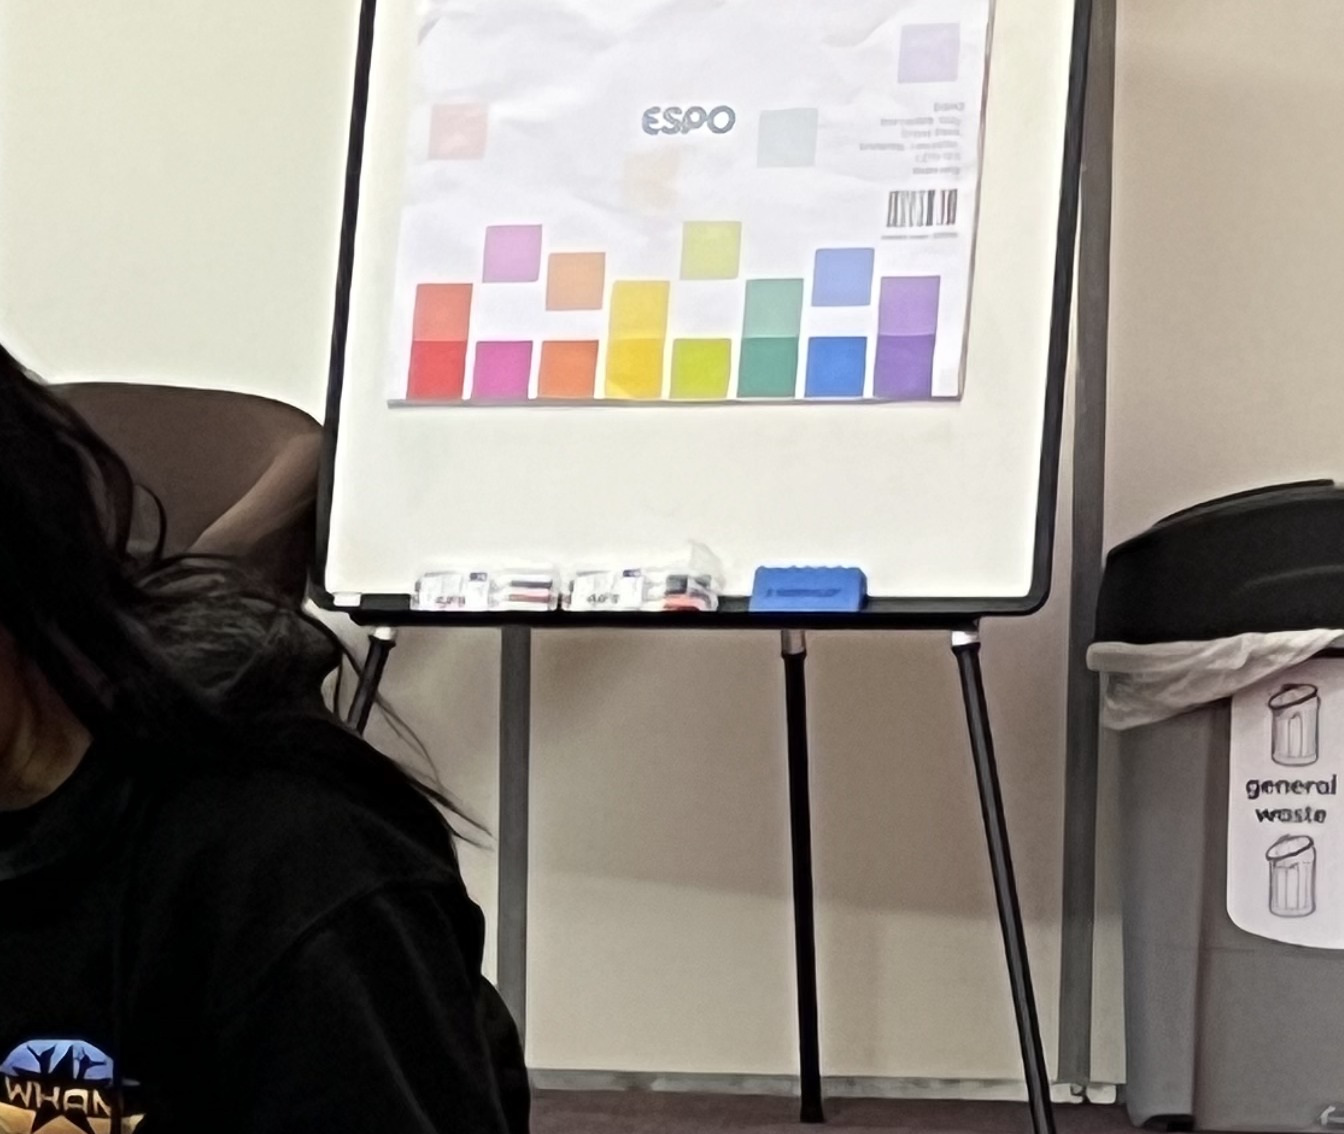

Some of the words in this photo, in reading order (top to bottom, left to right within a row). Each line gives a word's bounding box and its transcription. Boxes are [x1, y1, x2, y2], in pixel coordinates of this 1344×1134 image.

[641, 105, 736, 135] ESPO
[1245, 773, 1337, 800] general
[1255, 806, 1327, 823] waste
